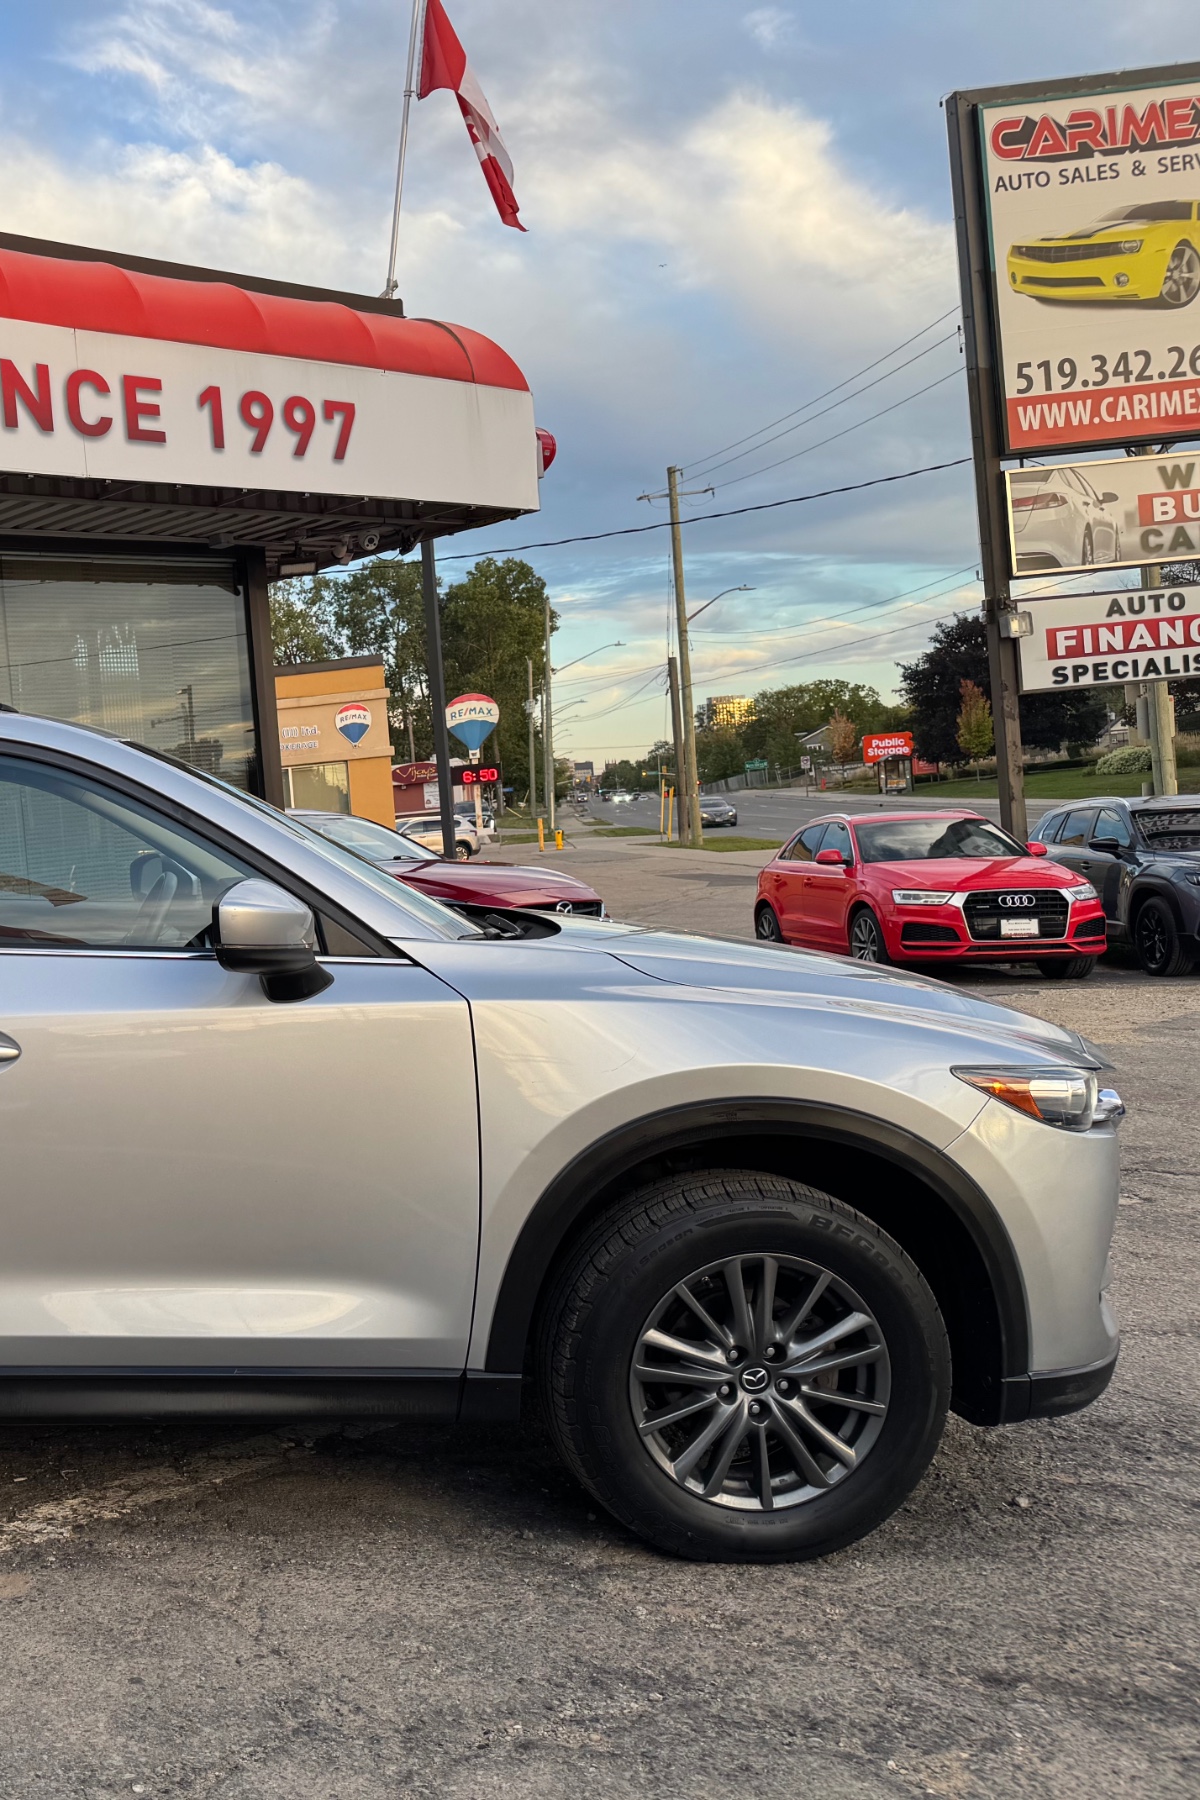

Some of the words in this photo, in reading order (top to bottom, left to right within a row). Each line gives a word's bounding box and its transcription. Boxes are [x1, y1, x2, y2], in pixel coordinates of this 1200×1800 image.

[994, 171, 1050, 192] AUTO
[1059, 163, 1120, 185] SALES
[1131, 160, 1146, 176] &
[199, 385, 356, 460] 1997
[1157, 462, 1200, 490] W
[1140, 526, 1200, 554] CA
[1106, 592, 1186, 618] AUTO
[340, 713, 367, 723] RE/MAX
[450, 706, 493, 720] RE/MAX
[868, 745, 910, 756] Storage
[872, 738, 905, 748] Public
[462, 768, 498, 783] 6:50
